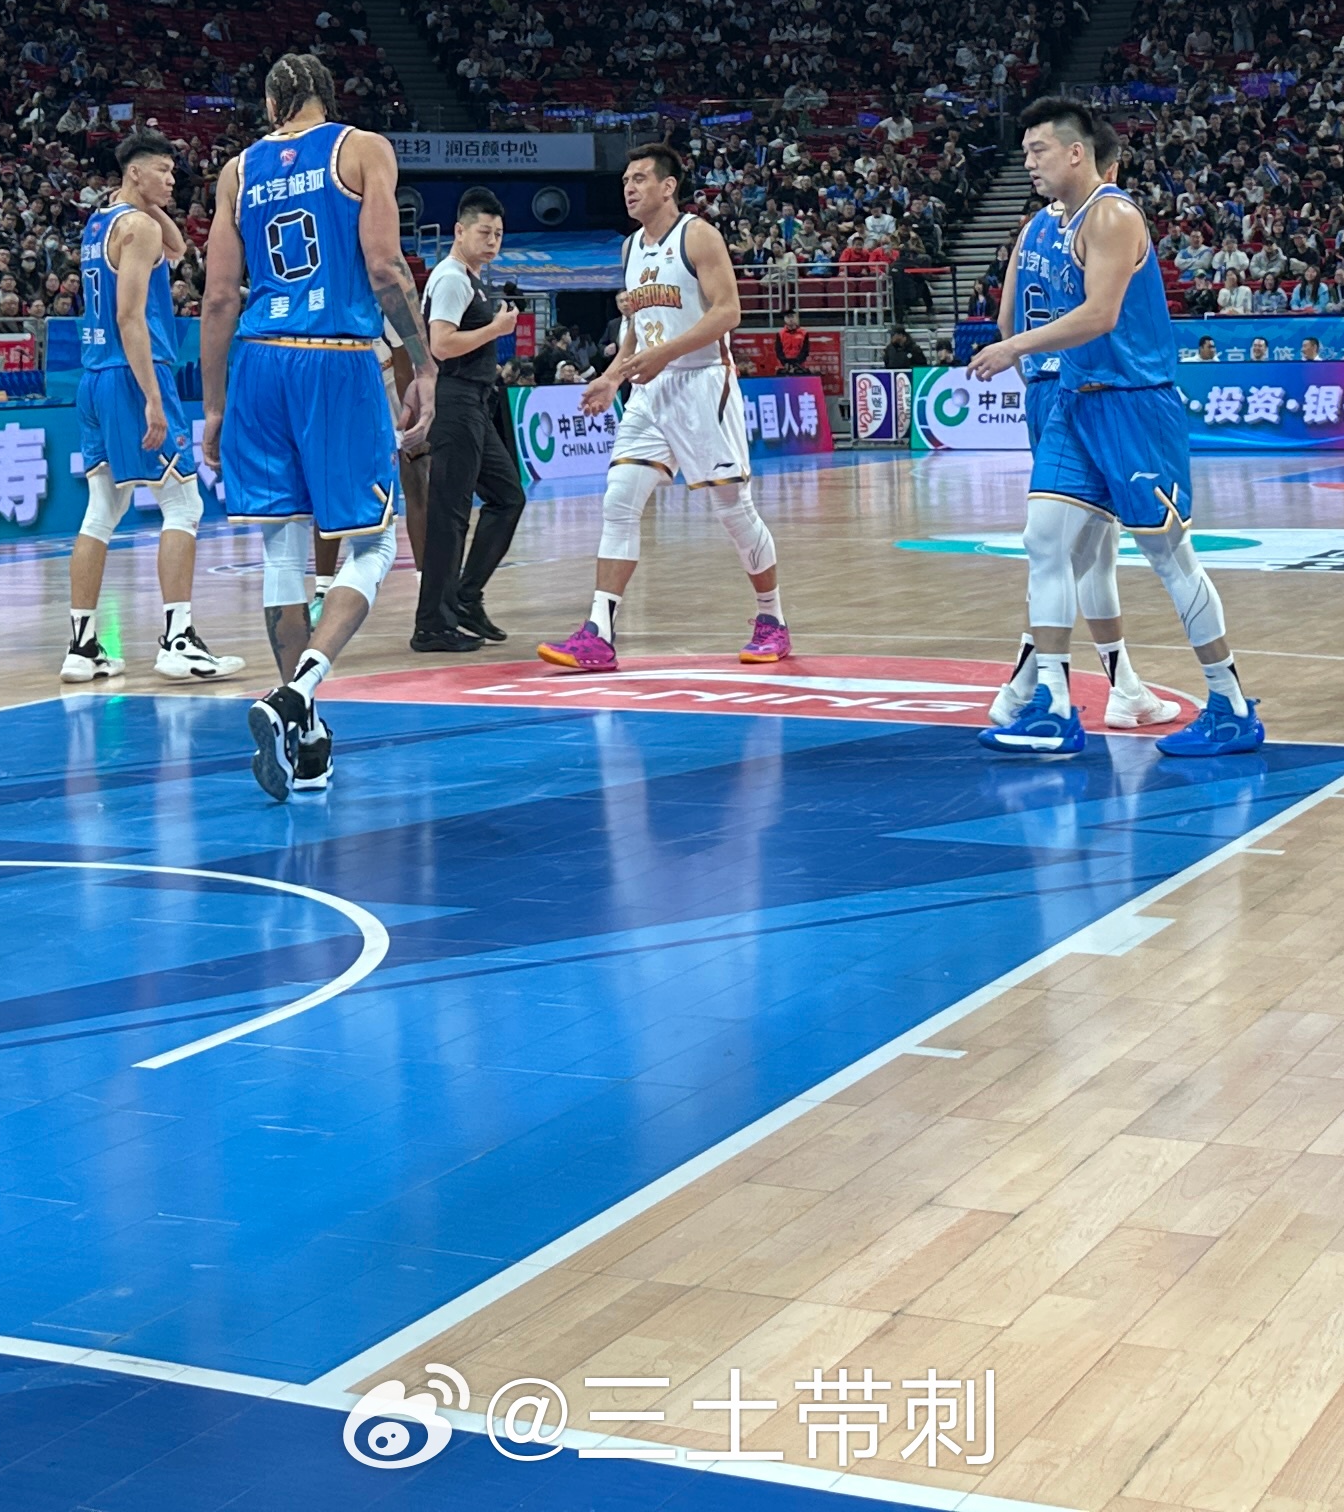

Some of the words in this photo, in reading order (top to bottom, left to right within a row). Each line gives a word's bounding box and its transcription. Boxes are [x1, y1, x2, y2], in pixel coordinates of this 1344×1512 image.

[445, 141, 538, 157] 润百颜中心
[247, 167, 326, 209] 北汽极狐
[265, 208, 322, 283] 0
[644, 321, 664, 348] 22
[978, 391, 1021, 411] 中国
[558, 412, 616, 440] 中国人寿
[978, 413, 1027, 425] CHINA
[562, 443, 596, 457] CHINA
[599, 441, 615, 456] LIF
